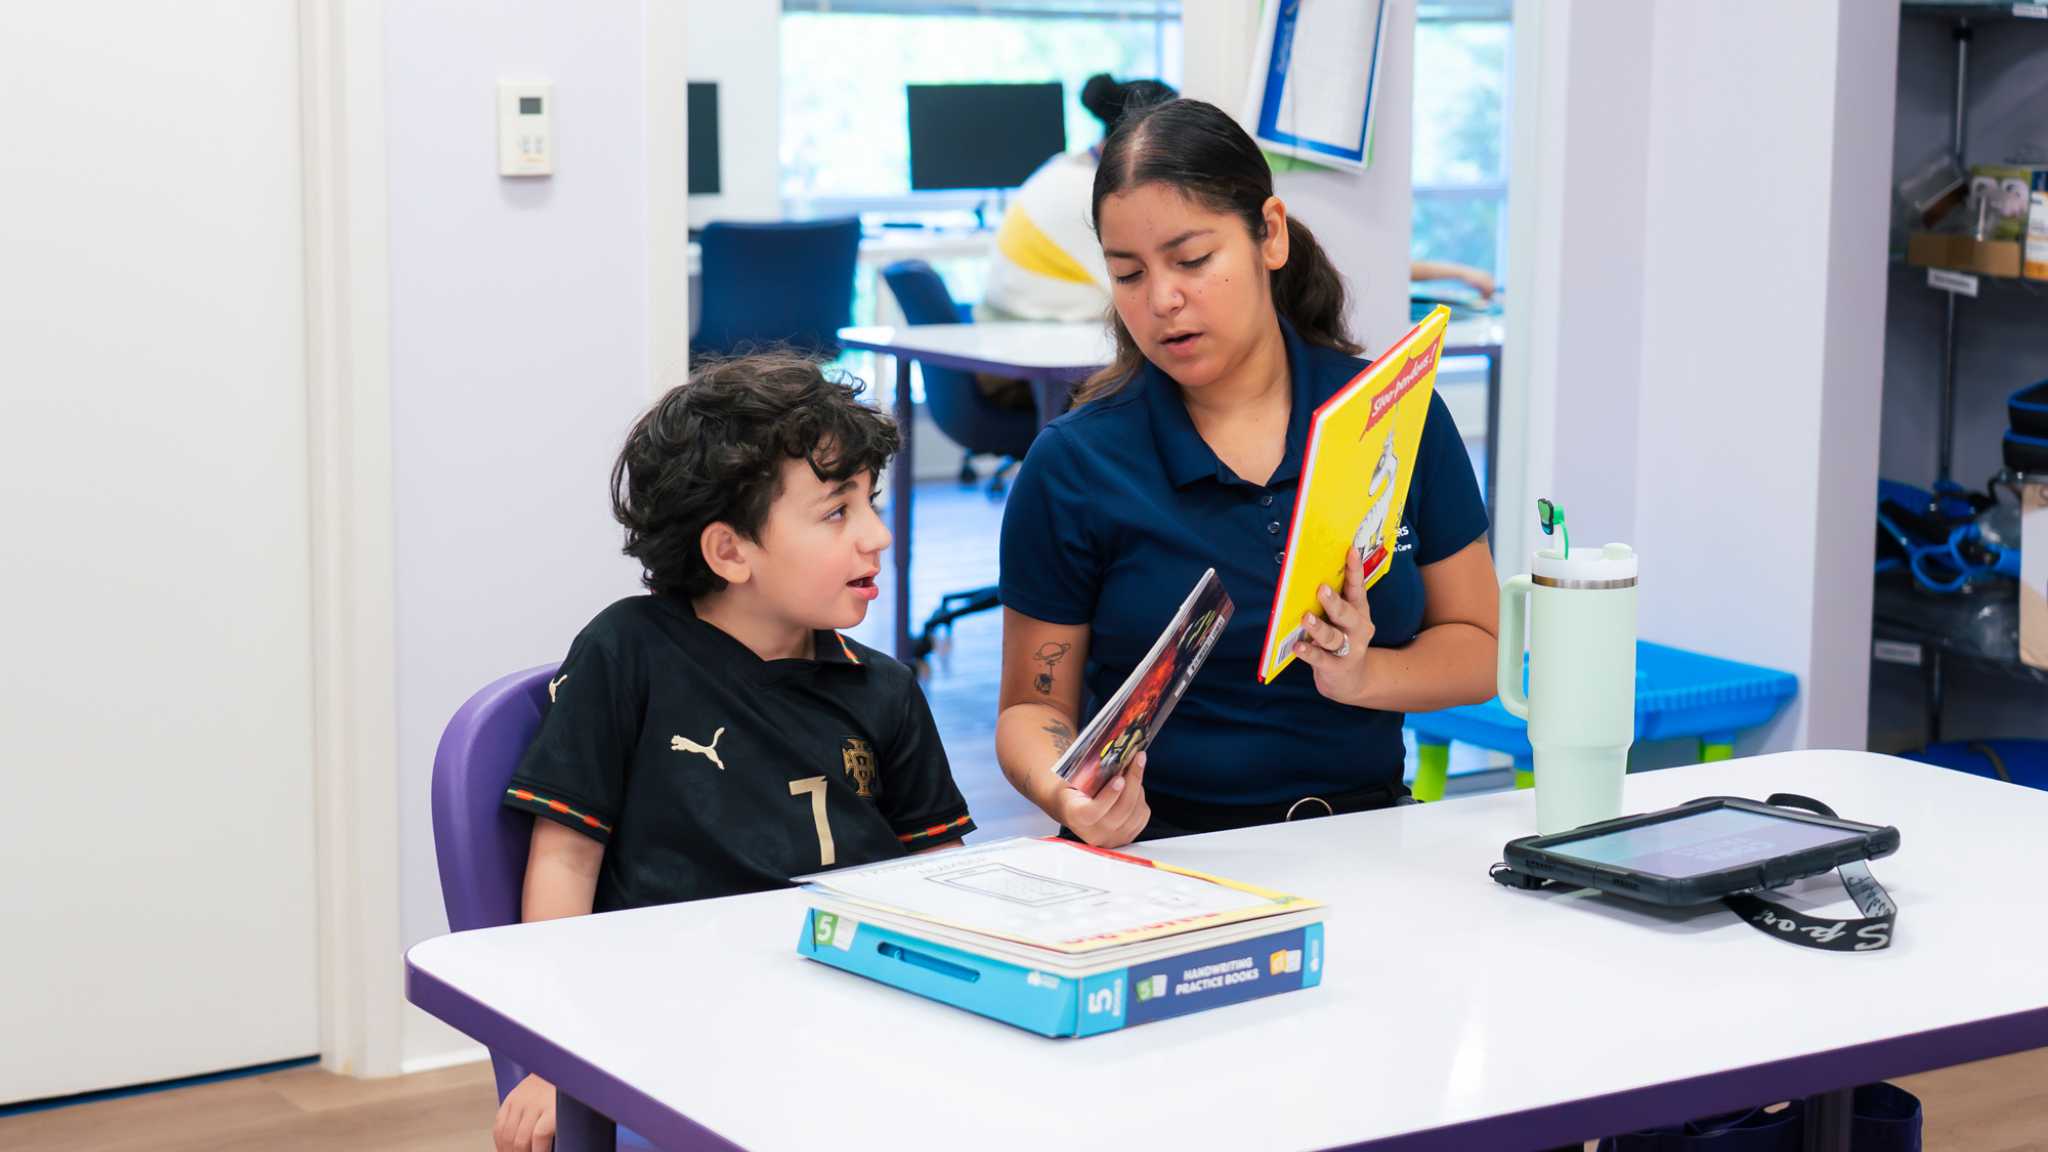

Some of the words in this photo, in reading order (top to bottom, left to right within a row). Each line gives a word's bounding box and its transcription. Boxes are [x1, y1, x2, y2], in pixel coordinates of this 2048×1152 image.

[788, 775, 836, 866] 7
[817, 914, 834, 942] 5
[1752, 909, 1890, 951] Spor
[1175, 975, 1224, 995] PRACTICE
[1225, 968, 1259, 985] BOOKS
[1183, 957, 1253, 980] HANDWRITING
[1088, 989, 1113, 1014] 5
